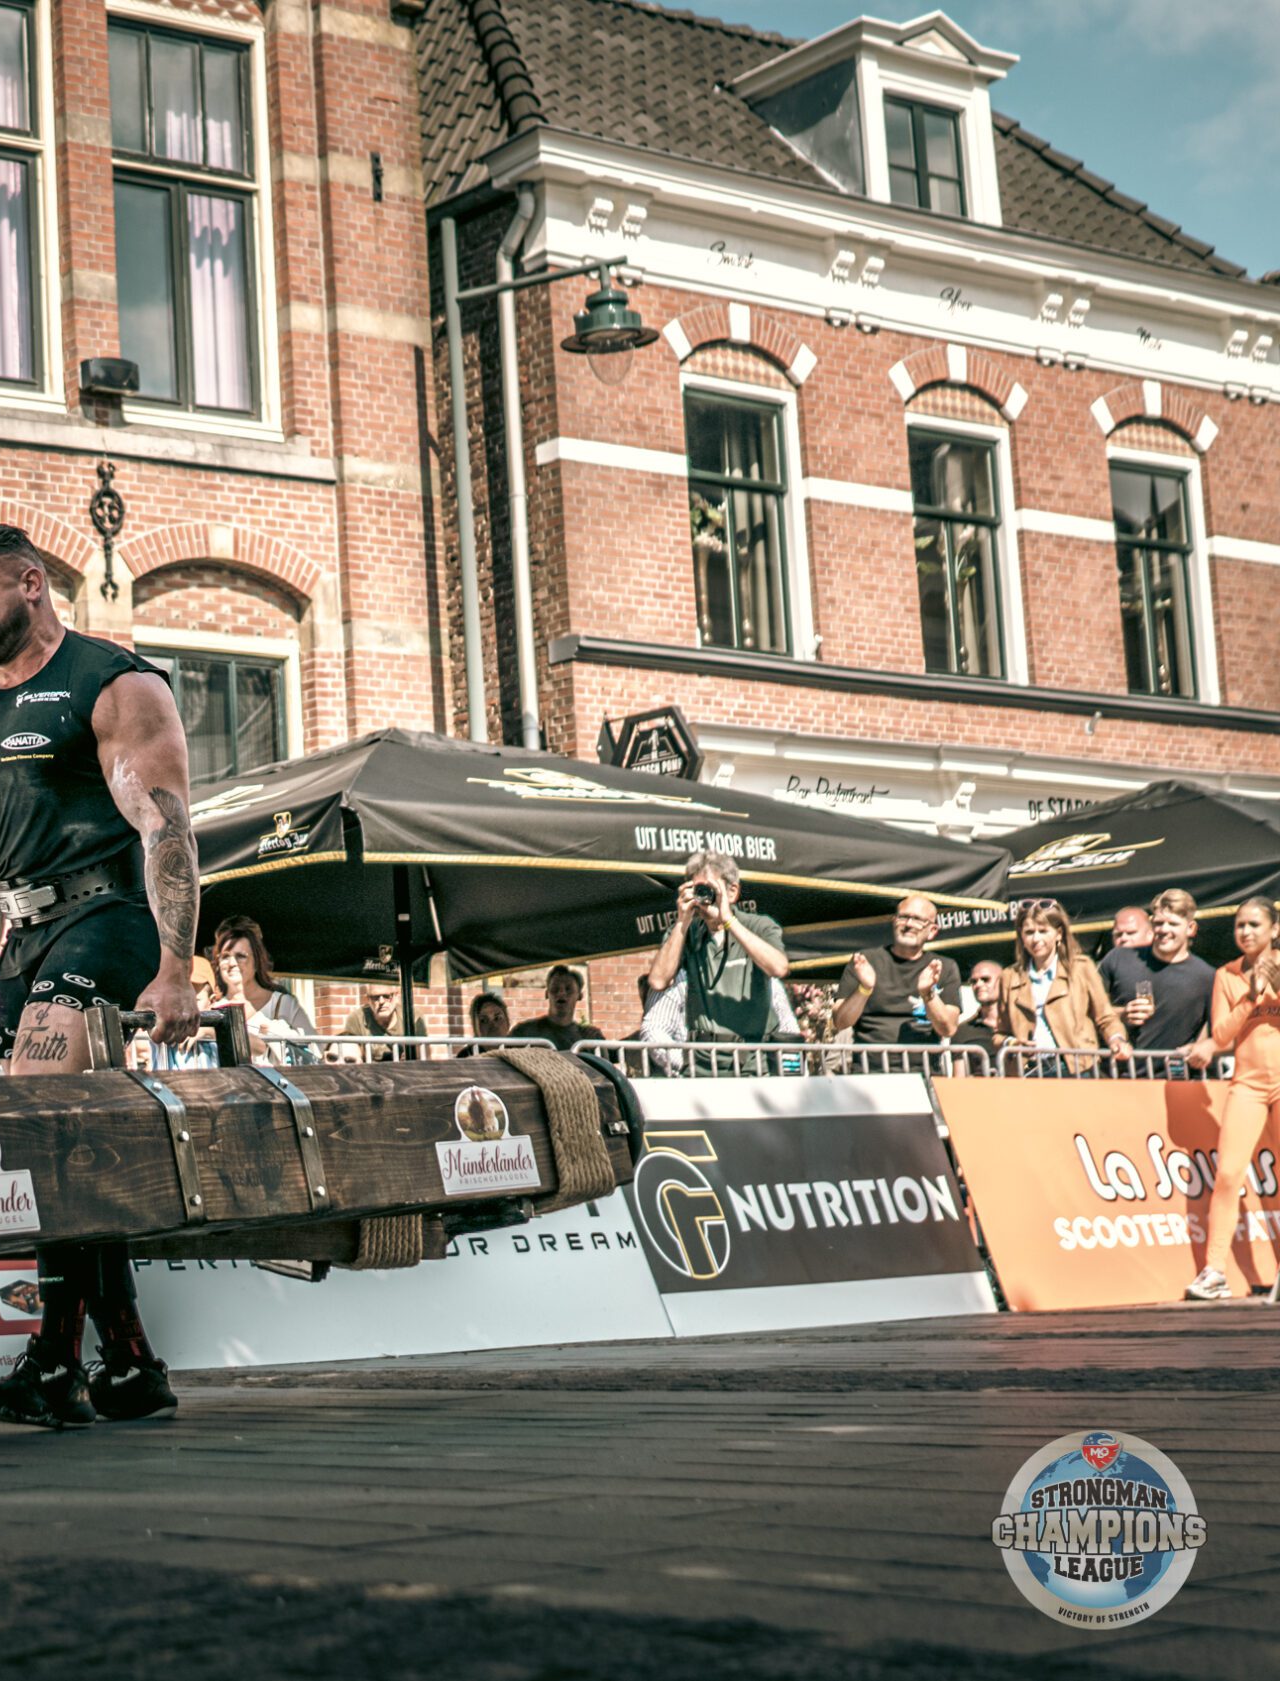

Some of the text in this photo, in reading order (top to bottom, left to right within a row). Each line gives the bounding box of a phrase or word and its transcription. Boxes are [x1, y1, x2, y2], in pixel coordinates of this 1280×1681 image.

[4, 735, 45, 748] PANATTA
[258, 834, 293, 855] Hertog
[634, 826, 777, 862] UIT LIEFDE VOOR BIER
[636, 914, 656, 934] UIT
[738, 900, 758, 914] IER
[362, 958, 391, 973] Hertog
[16, 1025, 69, 1062] Faith
[443, 1143, 534, 1180] Münsterländer
[1073, 1132, 1148, 1202] La
[726, 1174, 960, 1232] NUTRITION
[511, 1231, 638, 1253] DREAM
[1052, 1211, 1208, 1251] SCOOTERS
